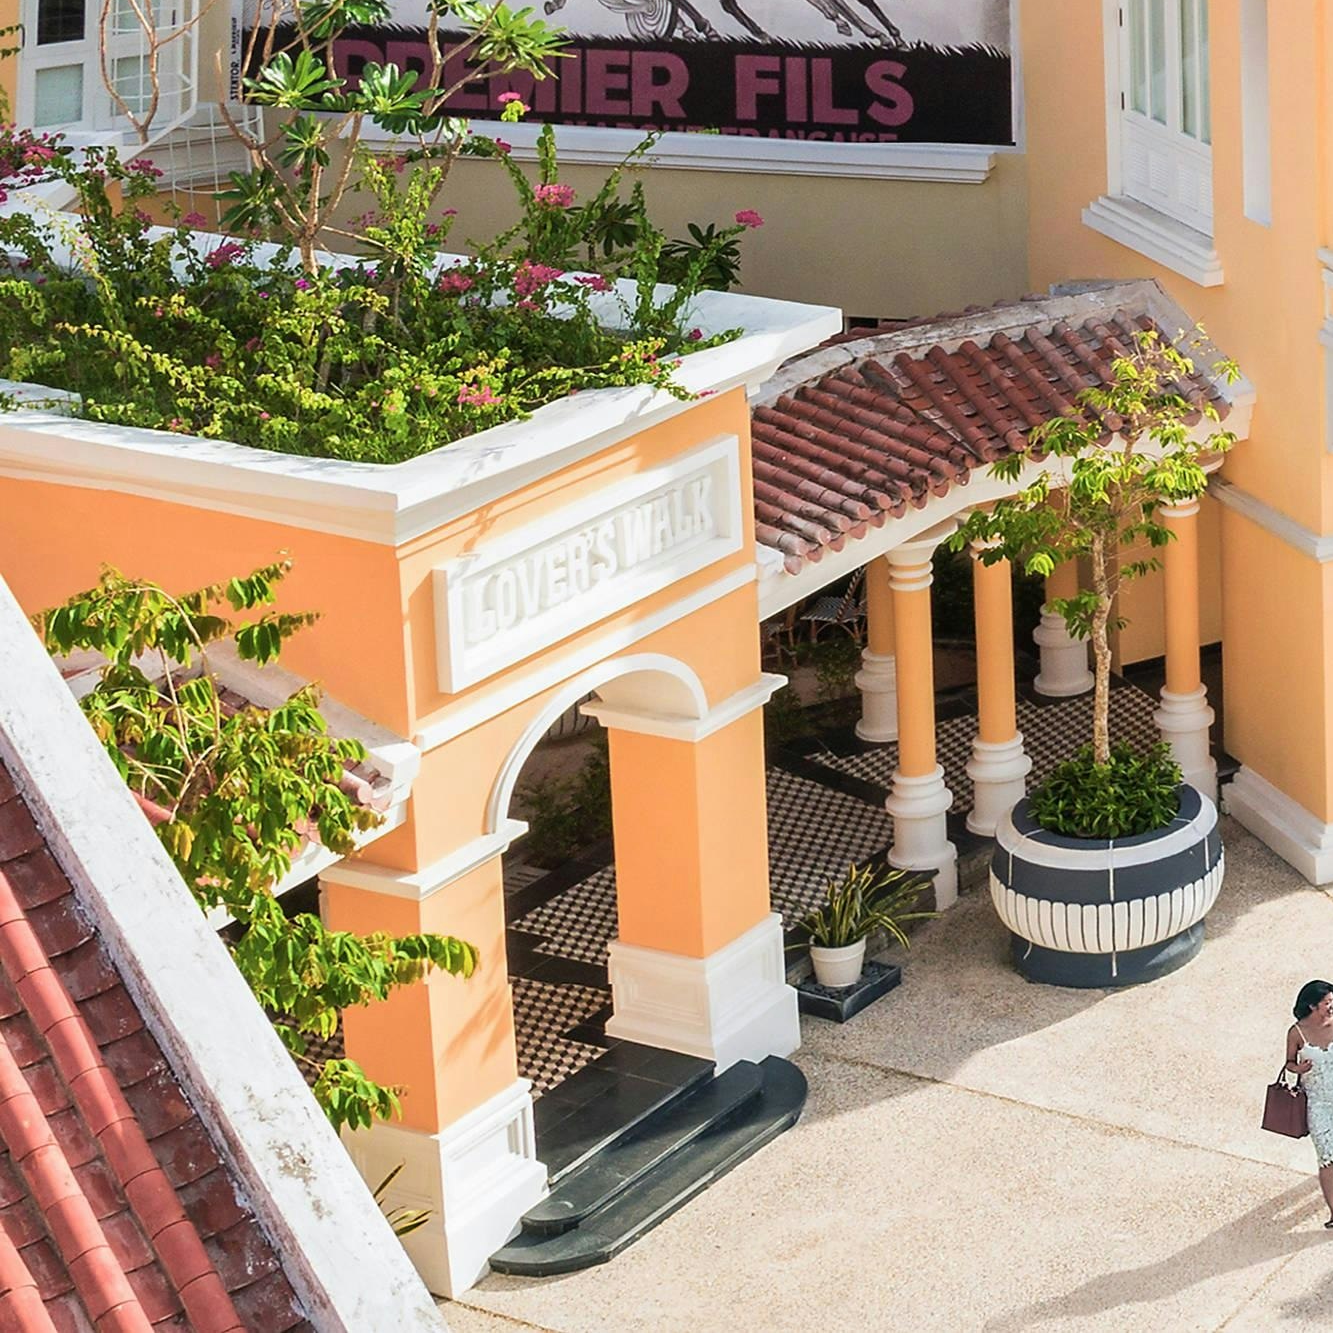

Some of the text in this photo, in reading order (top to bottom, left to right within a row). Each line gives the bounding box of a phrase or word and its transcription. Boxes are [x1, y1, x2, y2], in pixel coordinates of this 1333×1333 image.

[734, 54, 915, 127] FILS
[472, 475, 713, 640] LOVER'S WALK
